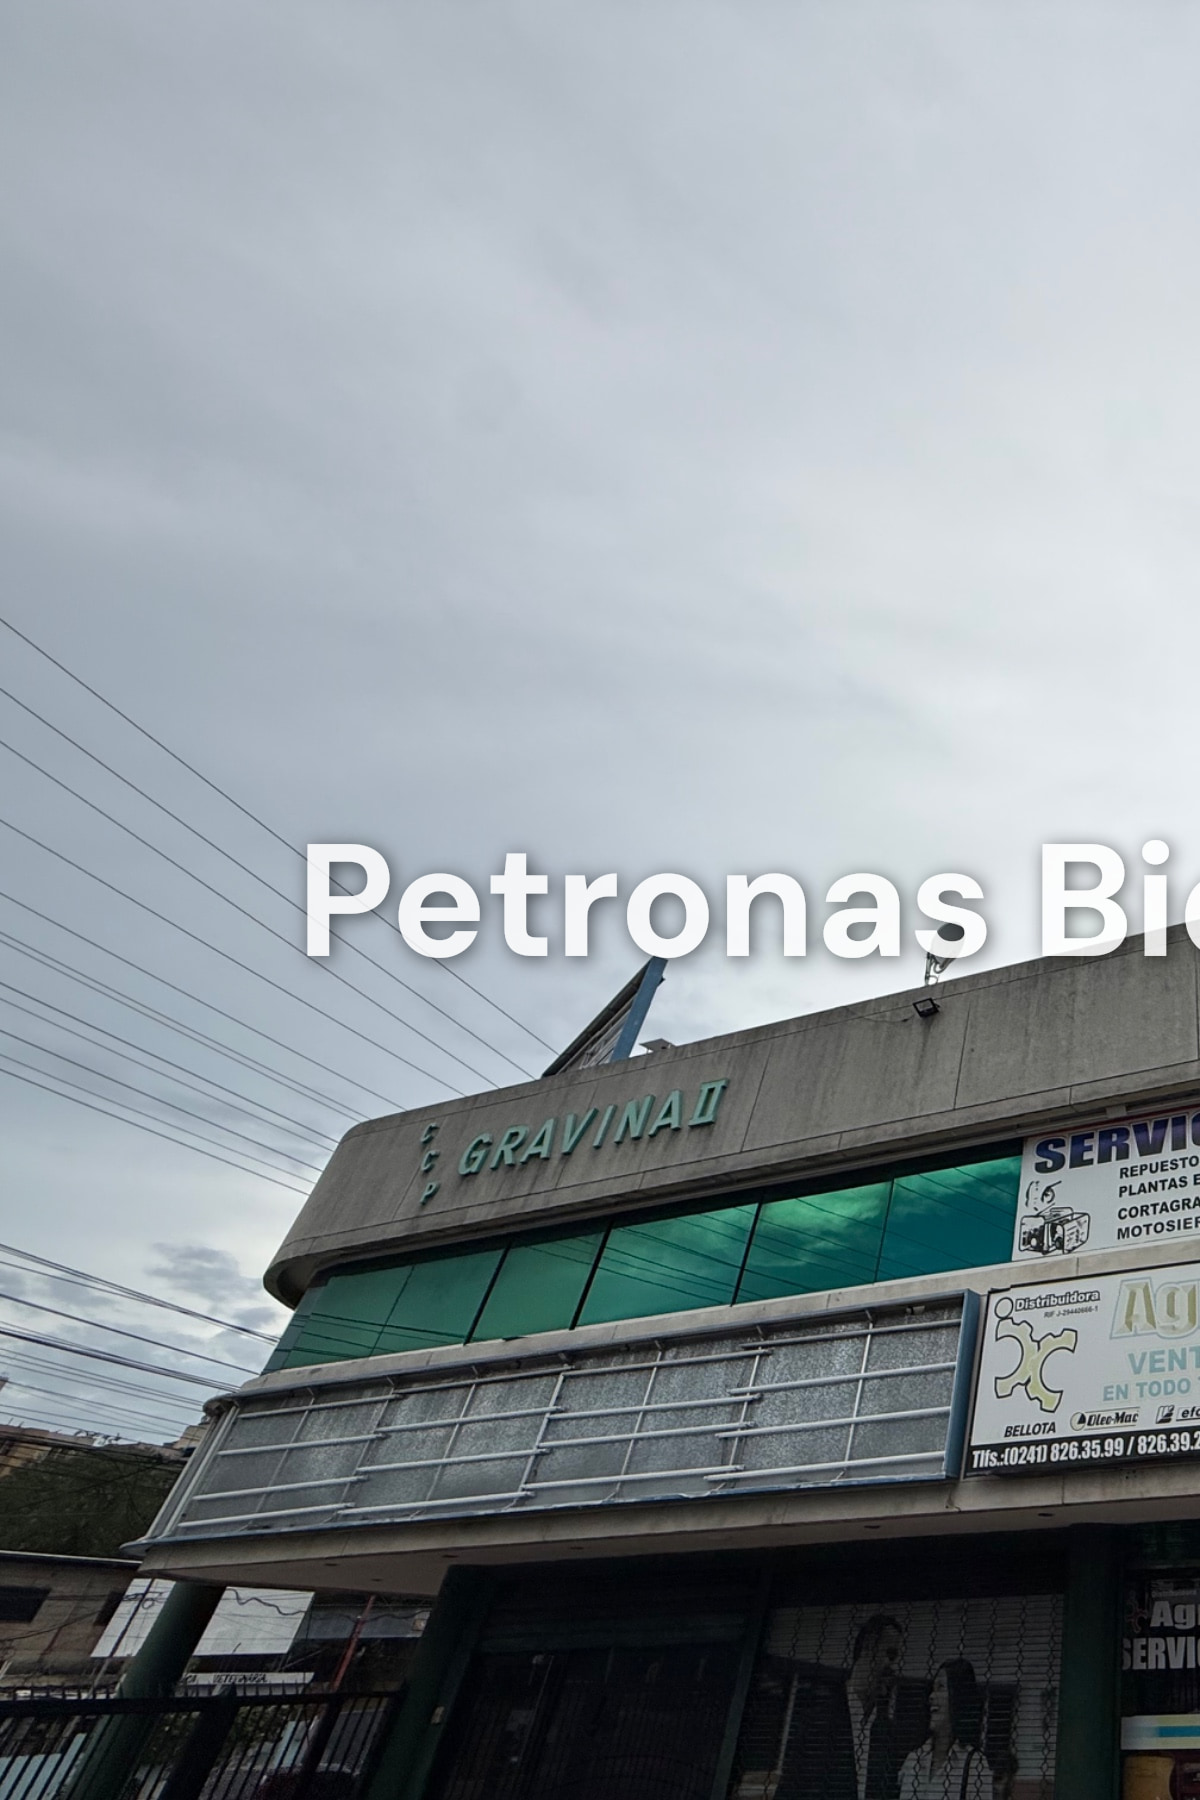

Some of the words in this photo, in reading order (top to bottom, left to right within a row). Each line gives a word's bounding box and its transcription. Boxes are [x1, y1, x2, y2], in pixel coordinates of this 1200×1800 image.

[457, 1089, 684, 1177] GRAVINA
[1118, 1175, 1188, 1198] PLANTAS
[1015, 1290, 1100, 1313] Distribuidora
[1102, 1383, 1130, 1402] EN
[1136, 1376, 1192, 1398] TODO
[1004, 1421, 1057, 1438] BELLOTA
[1050, 1436, 1124, 1462] 826.35.99
[1126, 1436, 1136, 1455] /
